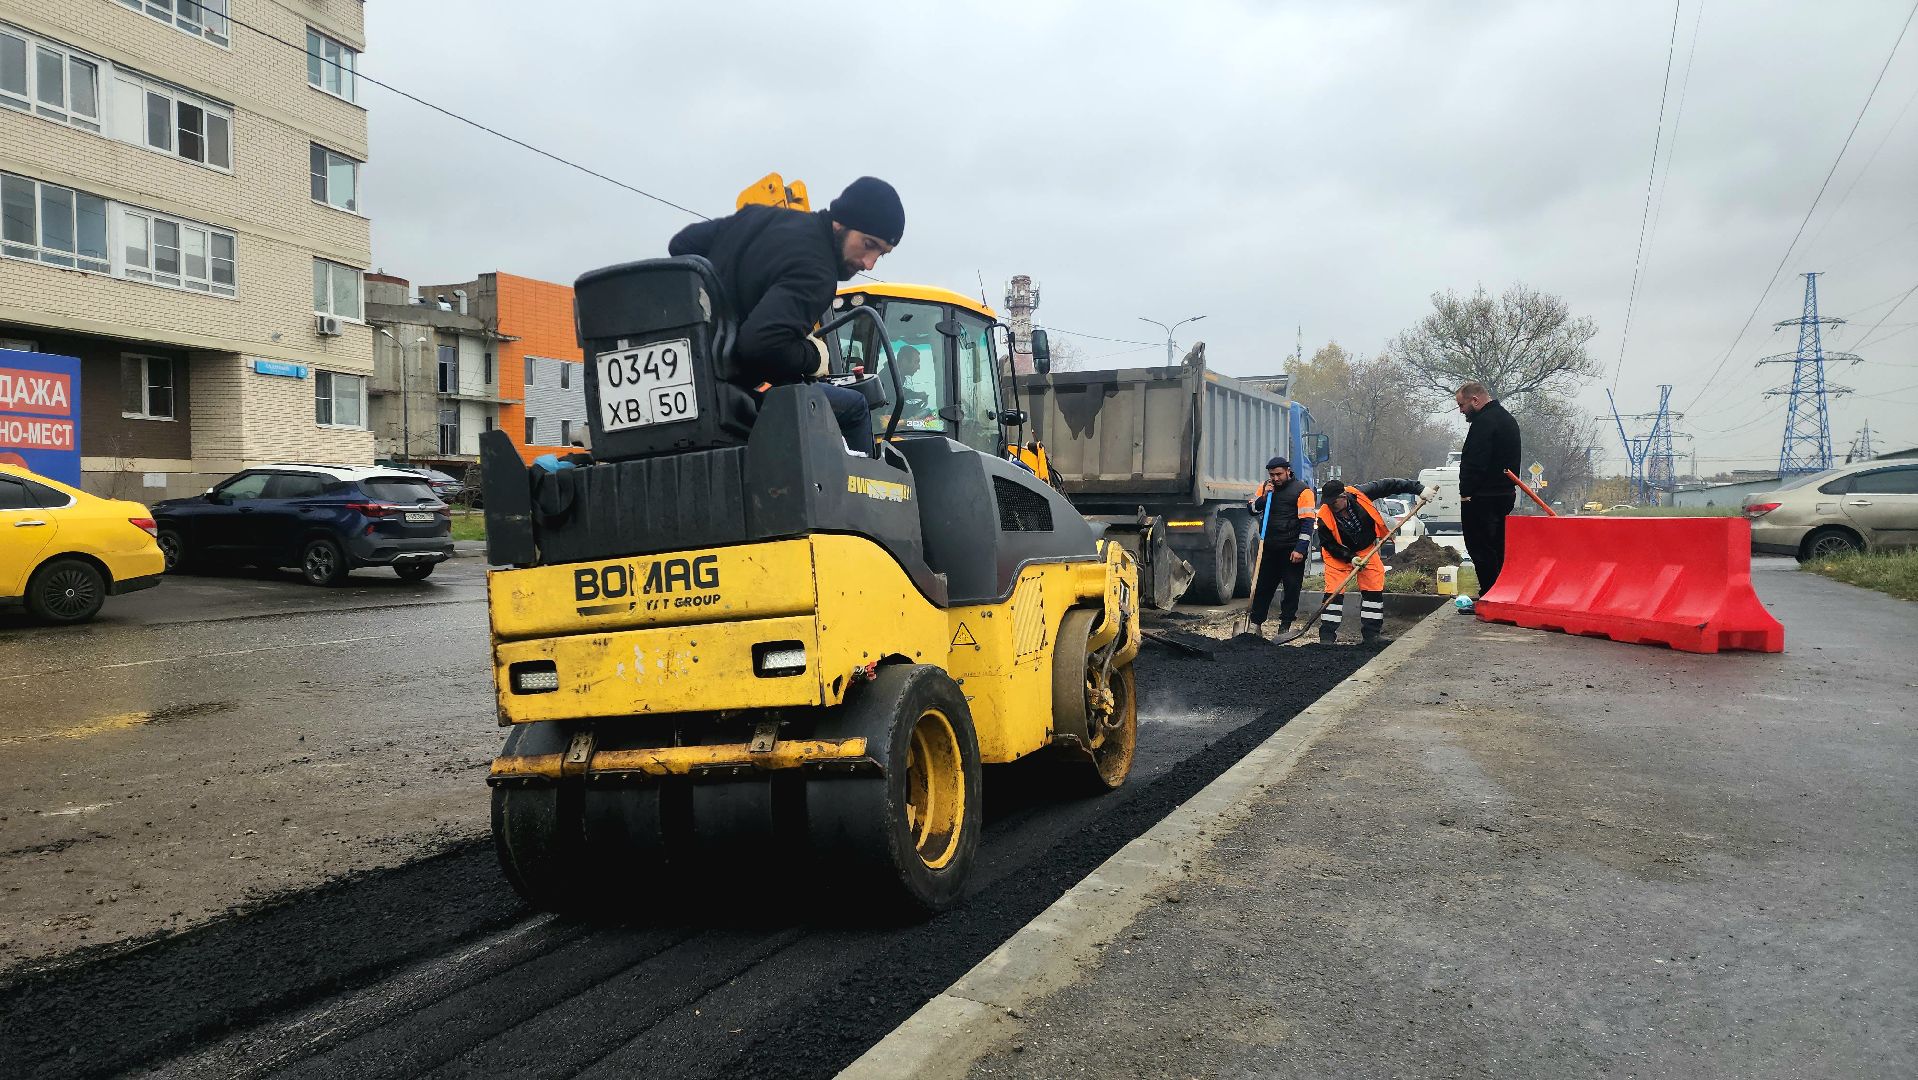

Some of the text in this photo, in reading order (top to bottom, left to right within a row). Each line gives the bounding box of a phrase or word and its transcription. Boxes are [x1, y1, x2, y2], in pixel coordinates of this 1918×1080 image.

[607, 348, 678, 388] 0349
[0, 375, 68, 408] ДАЖА
[608, 391, 687, 426] ХВ 50
[0, 420, 72, 446] НО-МЕСТ
[674, 594, 721, 608] GROUP
